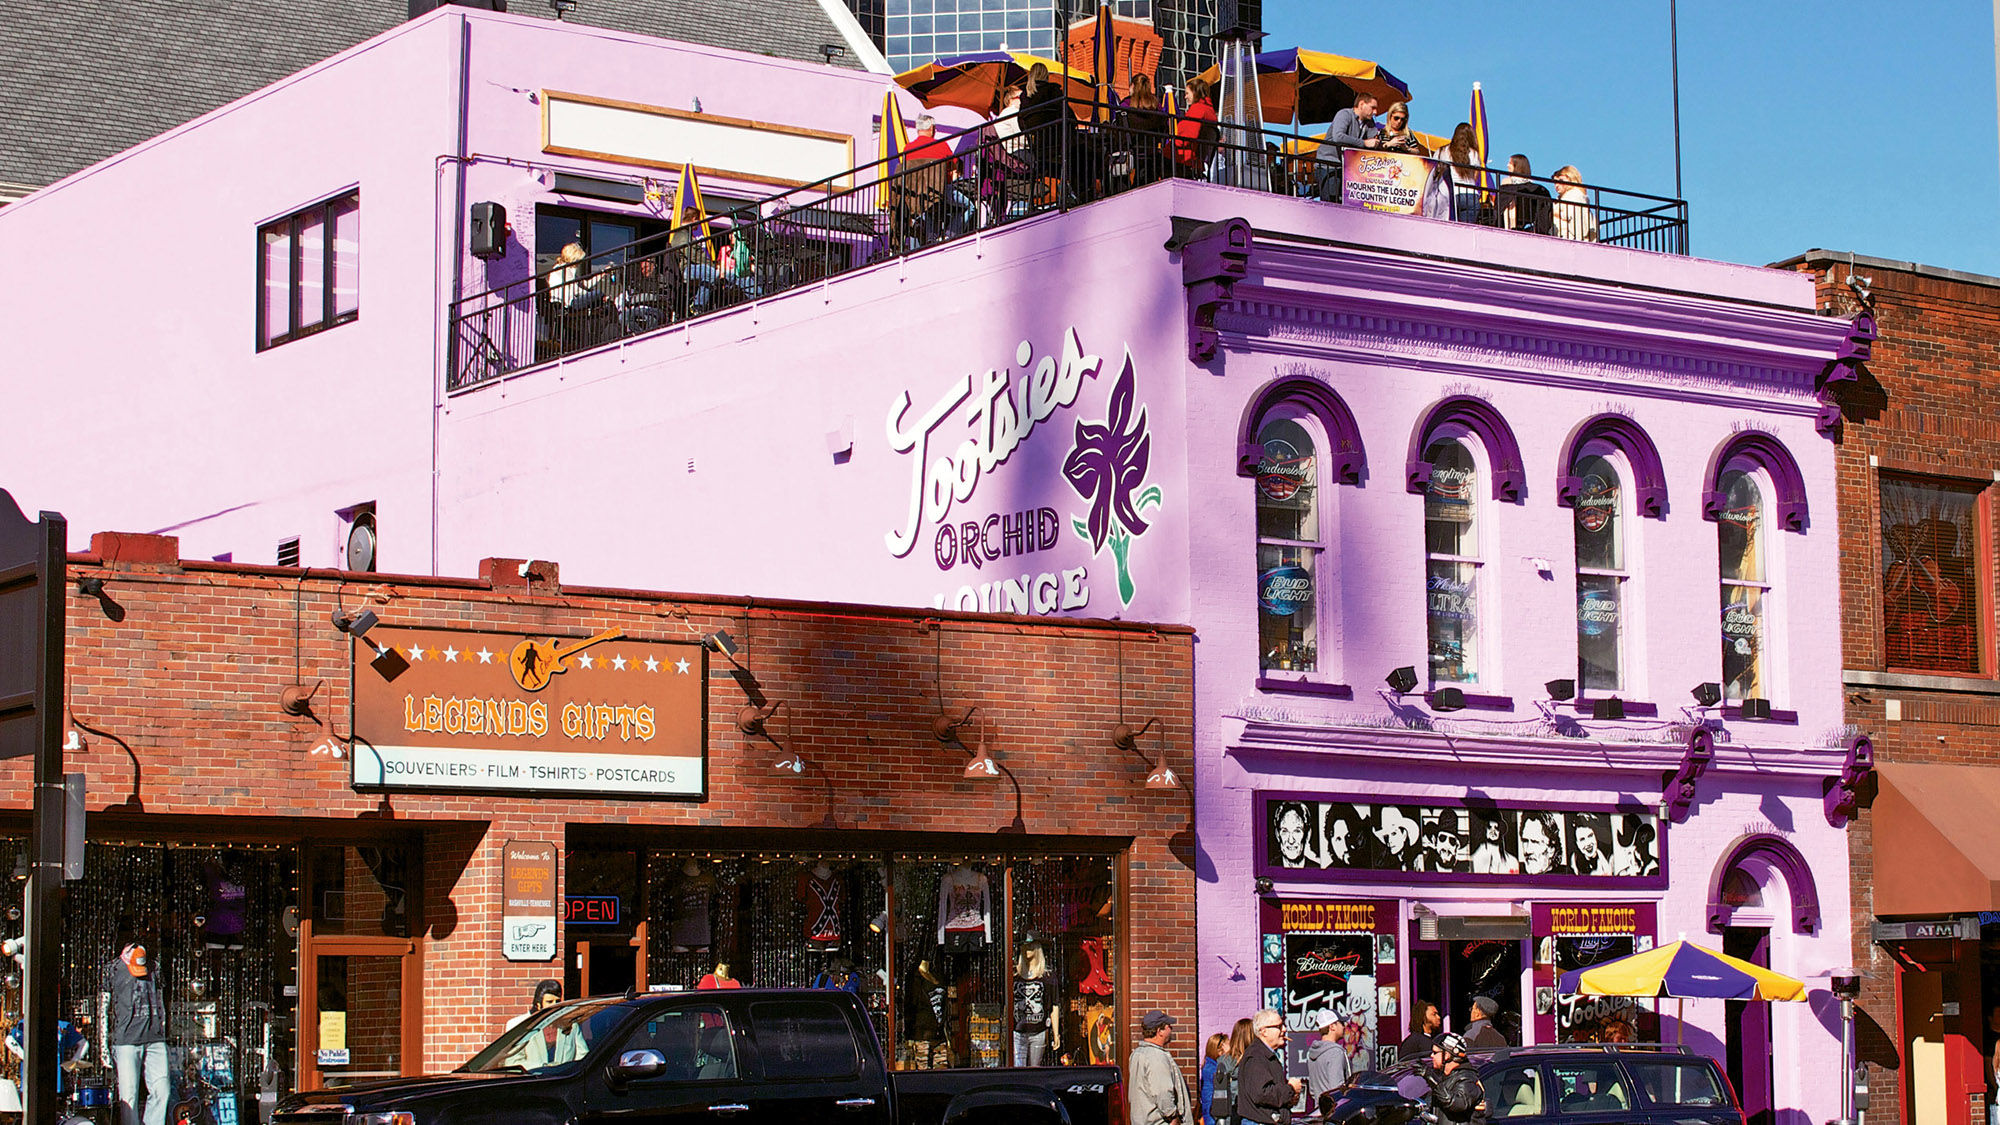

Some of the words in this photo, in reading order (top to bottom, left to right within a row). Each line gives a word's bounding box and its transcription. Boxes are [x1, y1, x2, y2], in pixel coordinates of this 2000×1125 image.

[1347, 182, 1376, 193] MOURNS
[1377, 186, 1389, 194] THE
[1390, 188, 1407, 197] LOSS
[1408, 190, 1418, 198] OF
[1356, 192, 1388, 203] COUNTRY
[1389, 197, 1415, 206] LEGEND
[885, 326, 1103, 558] Tootsies
[935, 506, 1059, 570] ORCHID
[1271, 576, 1309, 589] BUD
[1263, 588, 1314, 601] LIGHT
[1429, 593, 1475, 613] LTRA
[1582, 598, 1615, 611] BUD
[1577, 609, 1618, 622] LIGHT
[1726, 611, 1755, 623] BUD
[1722, 622, 1756, 635] LIGHT
[404, 694, 549, 738] LEGENDS
[560, 701, 656, 742] GIFTS
[386, 761, 477, 776] SOUVENIERS
[488, 765, 520, 778] FILM
[530, 766, 587, 780] TSHIRTS
[596, 769, 676, 783] POSTCARDS
[510, 850, 540, 860] Welcome
[511, 867, 550, 880] LEGENDS
[518, 881, 543, 893] GIFTS
[1282, 904, 1325, 930] WORLD
[1326, 904, 1376, 930] FAMOUS
[1551, 908, 1590, 933] WORLD
[1591, 908, 1636, 933] FAMOUS
[1916, 925, 1953, 936] ATM
[511, 944, 530, 953] ENTER
[532, 944, 547, 953] HERE
[1296, 957, 1358, 972] Budweiser
[1287, 990, 1372, 1033] Totsies
